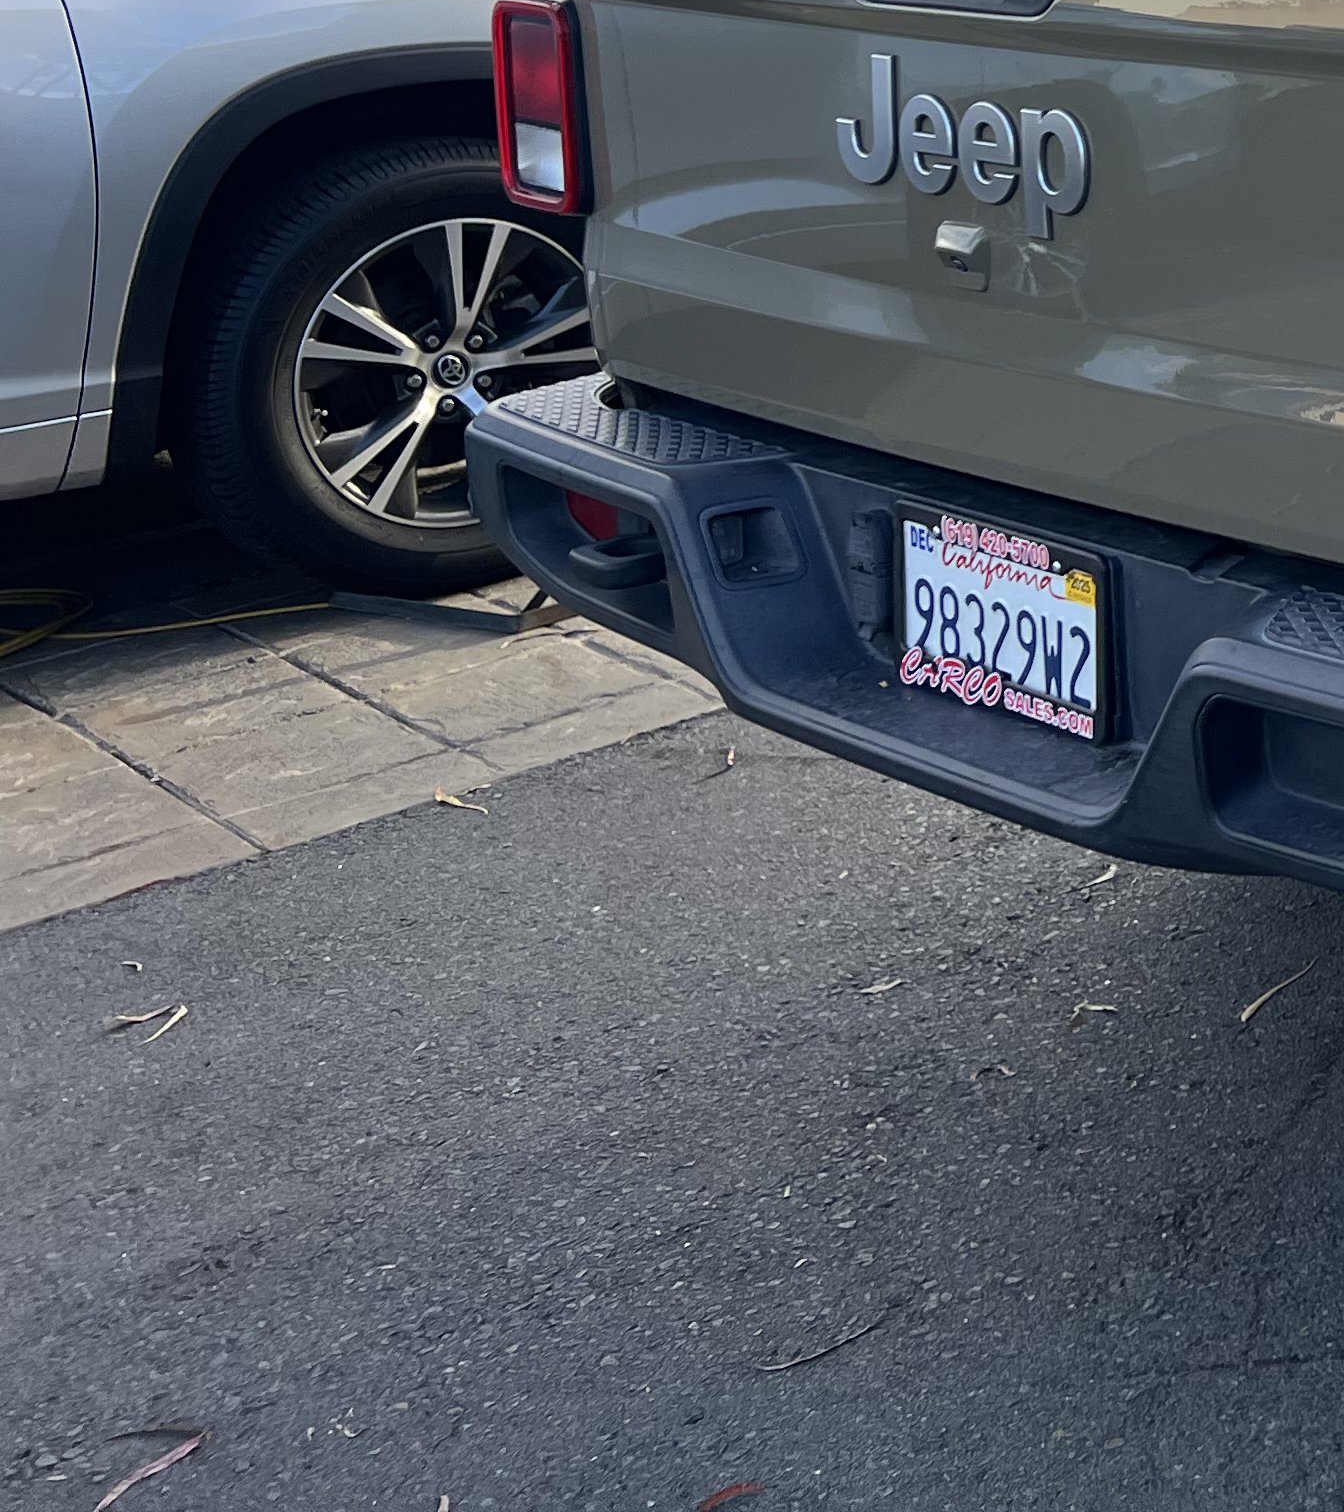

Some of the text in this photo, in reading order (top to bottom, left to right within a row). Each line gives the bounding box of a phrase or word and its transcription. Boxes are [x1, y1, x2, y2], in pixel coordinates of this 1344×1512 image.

[836, 54, 1092, 240] Jeep
[910, 525, 934, 553] DEC
[940, 514, 1050, 571] (619) 420-5700
[941, 541, 1056, 593] California
[914, 578, 1091, 710] 98329W2
[899, 646, 1094, 740] CARCO SALES.COM
